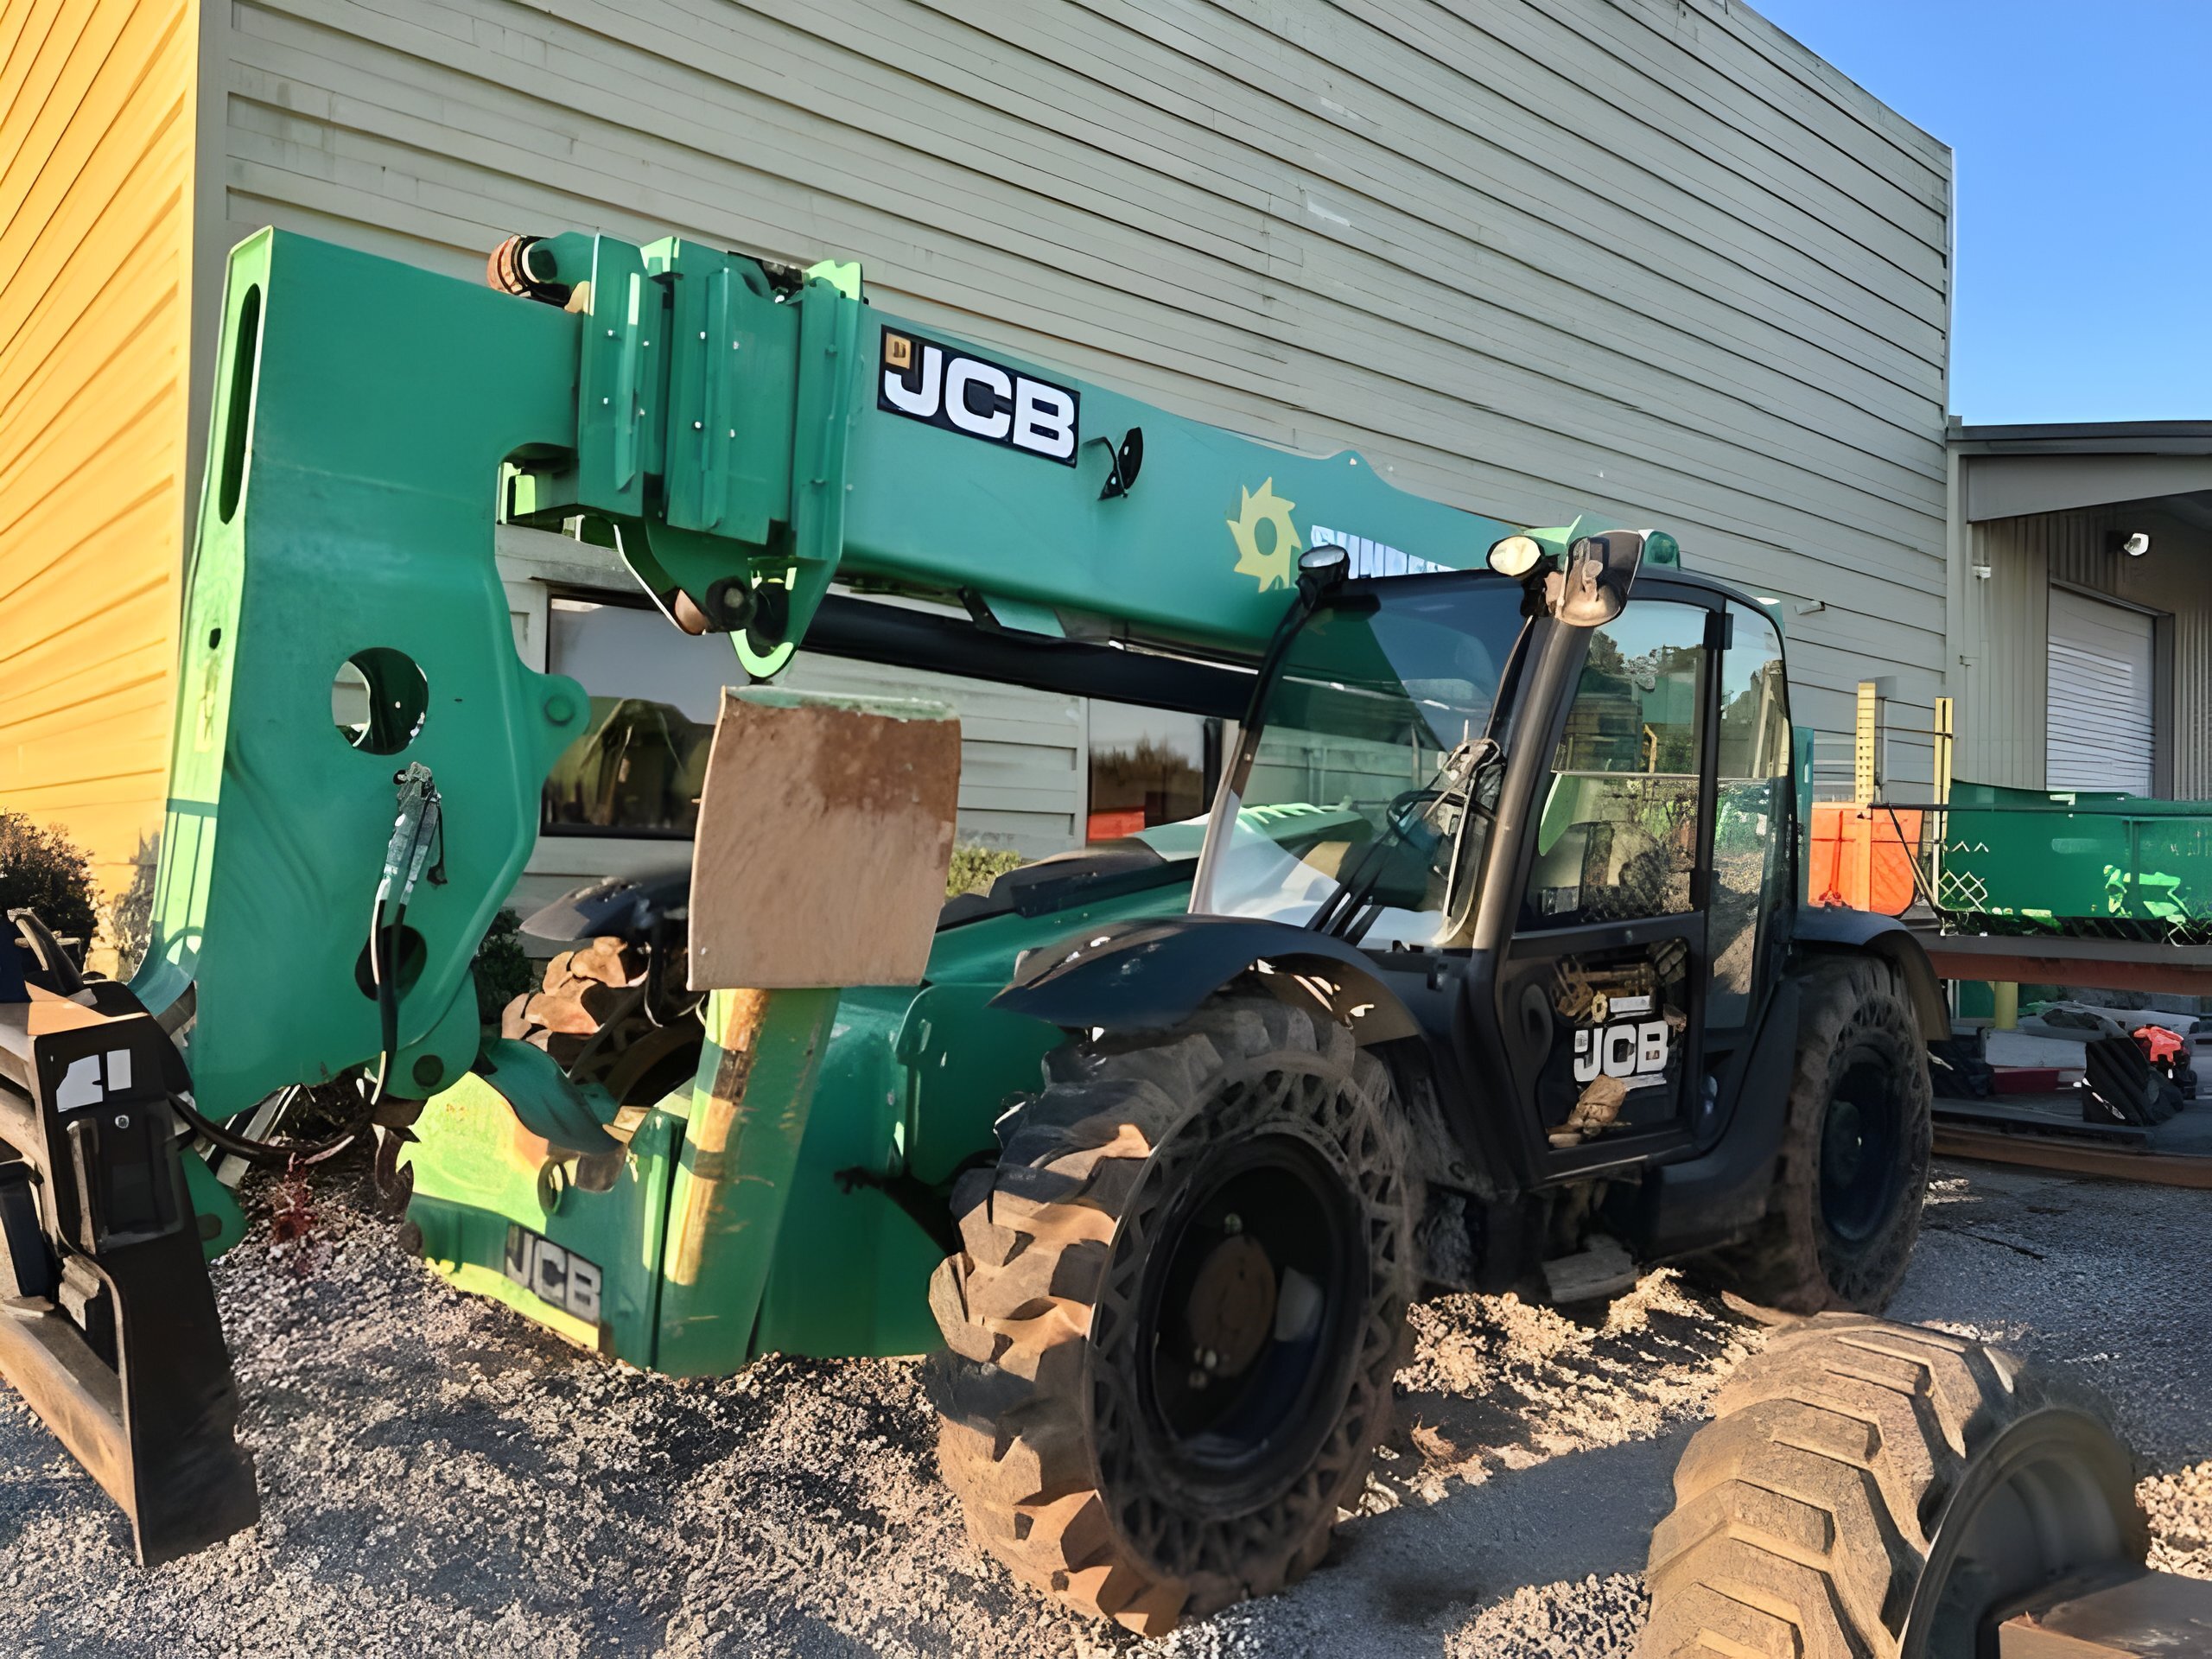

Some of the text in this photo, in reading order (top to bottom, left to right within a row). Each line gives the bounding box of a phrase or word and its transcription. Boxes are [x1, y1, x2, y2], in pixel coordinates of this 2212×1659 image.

[884, 346, 1075, 458] JCB
[1573, 1020, 1669, 1082] JCB
[506, 1230, 602, 1322] JCB
